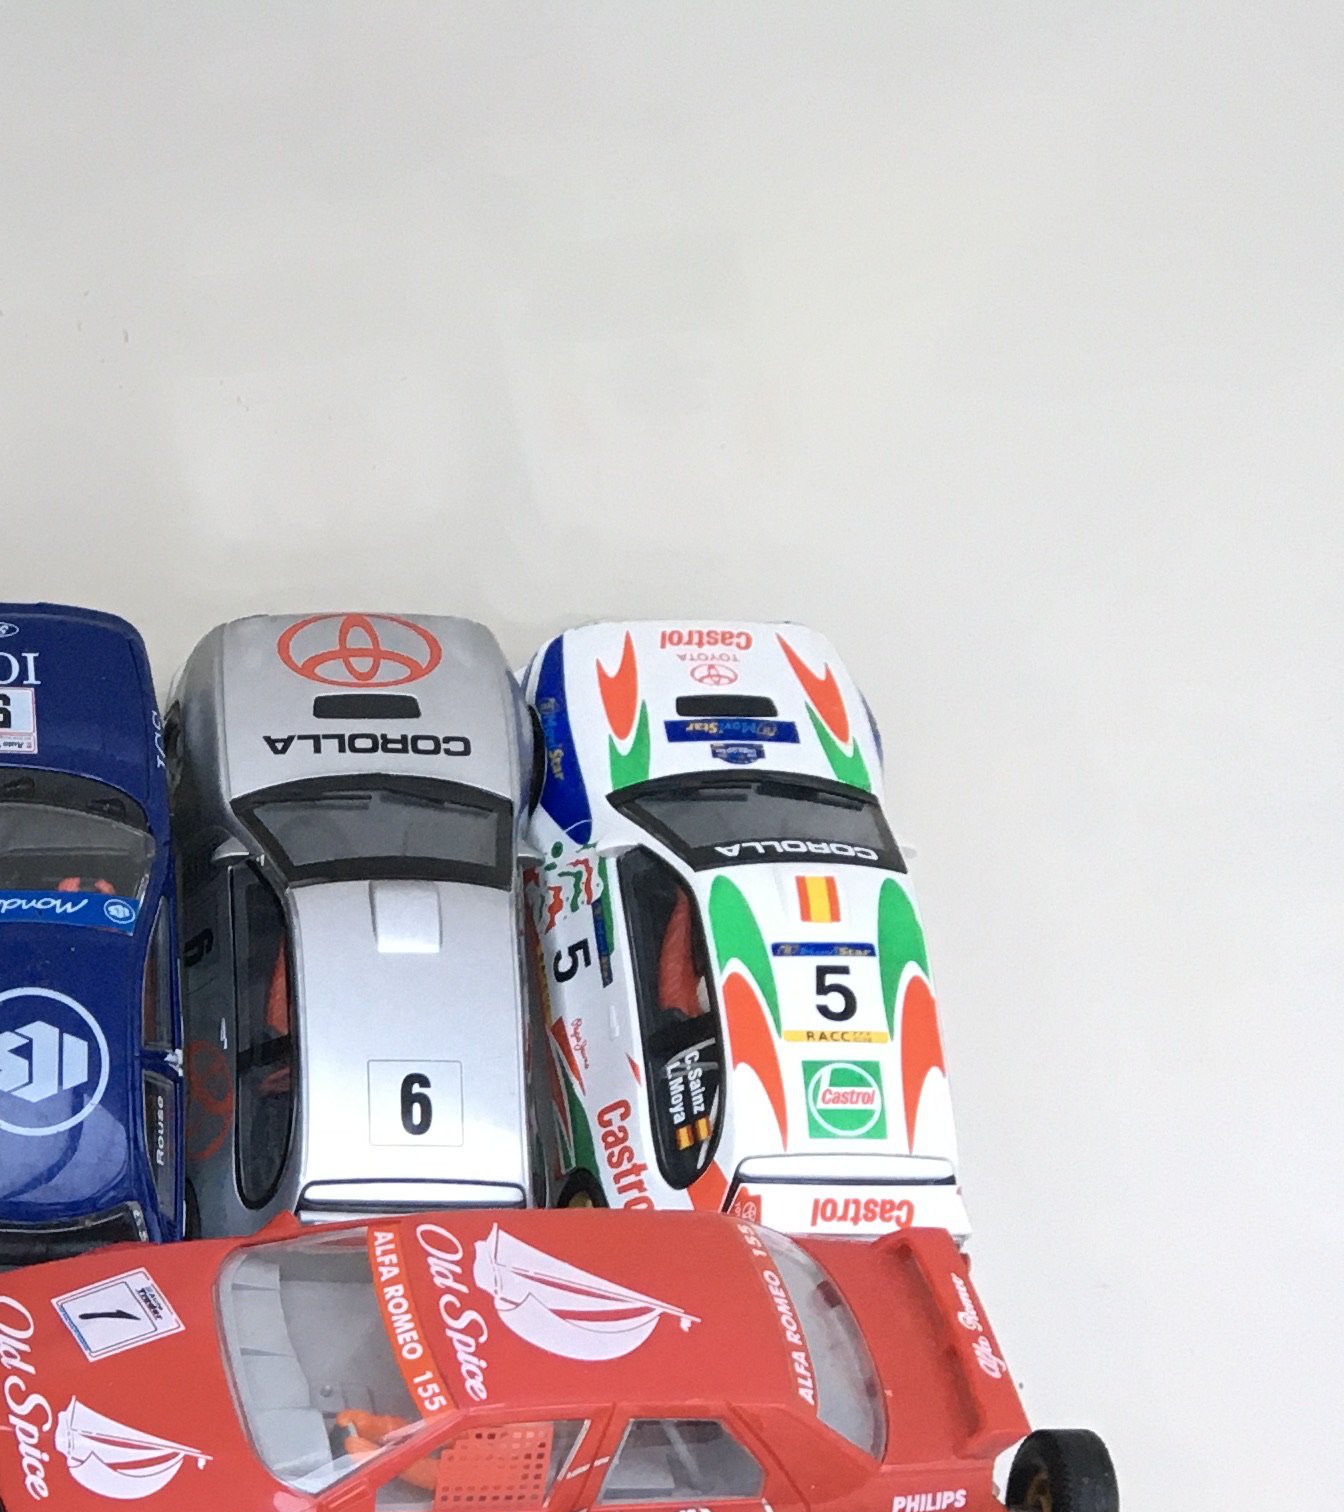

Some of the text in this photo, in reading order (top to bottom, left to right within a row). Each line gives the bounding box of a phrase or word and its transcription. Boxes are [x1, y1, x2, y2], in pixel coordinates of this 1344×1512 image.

[660, 629, 753, 651] Castrol
[676, 653, 740, 663] TOYOTA
[262, 733, 472, 757] COROLLA
[714, 839, 879, 862] COROLLA
[553, 937, 592, 984] 5
[815, 964, 857, 1022] 5
[806, 1031, 851, 1042] RACC
[400, 1072, 433, 1136] 6
[821, 1088, 876, 1106] Castrol
[155, 1095, 166, 1167] Rouse
[597, 1099, 655, 1211] Castro
[811, 1198, 915, 1227] Castrol
[373, 1230, 446, 1411] ALFA ROMEO 155
[416, 1223, 489, 1402] Old Spice
[741, 1223, 817, 1405] ALFA ROMEO 155
[950, 1273, 1007, 1379] Alfa Romeo
[4, 1373, 53, 1501] Spice
